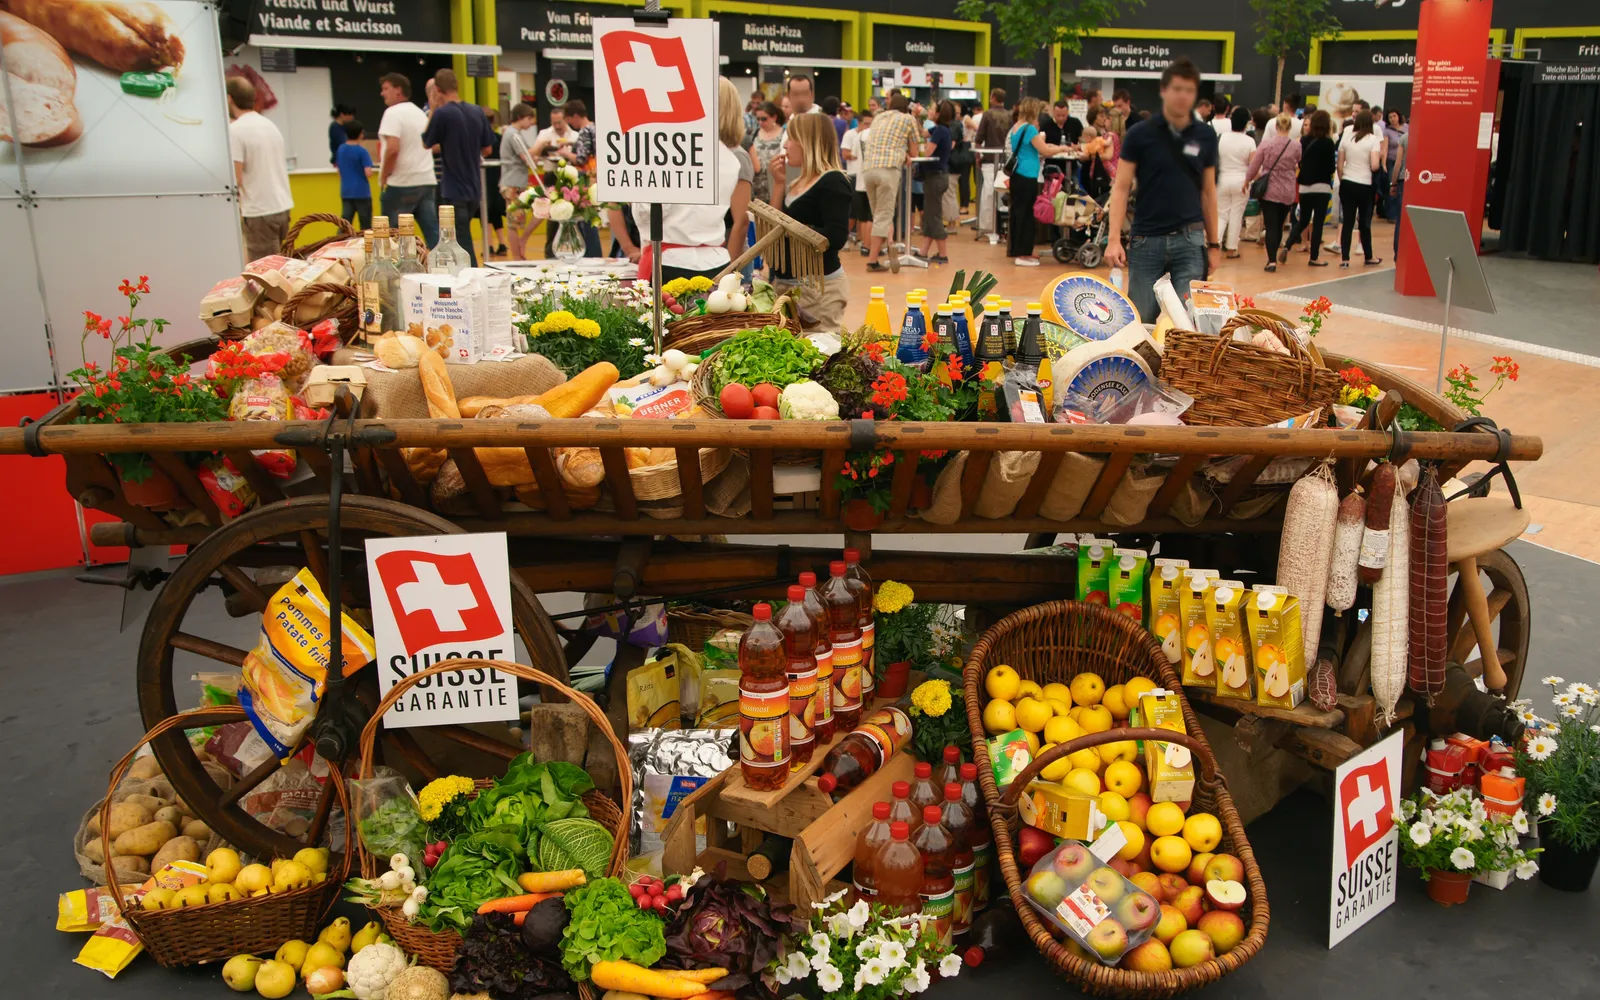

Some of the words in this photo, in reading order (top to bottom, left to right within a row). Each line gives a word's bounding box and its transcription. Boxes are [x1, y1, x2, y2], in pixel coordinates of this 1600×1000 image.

[322, 0, 349, 12] und
[353, 0, 396, 15] Wurst
[547, 10, 571, 25] Vom
[258, 13, 312, 31] Viande
[315, 17, 331, 31] et
[335, 18, 403, 35] Saucisson
[520, 27, 546, 41] Pure
[741, 38, 767, 52] Baked
[769, 40, 804, 54] Potatoes
[905, 41, 935, 54] Getränke
[1579, 44, 1600, 56] Frit
[1101, 57, 1122, 68] Dips
[1125, 57, 1137, 67] de
[606, 131, 704, 167] SUISSE
[607, 169, 704, 189] GARANTIE
[280, 596, 324, 641] Pommes
[276, 611, 309, 648] Patate
[390, 649, 506, 689] SUISSE
[394, 687, 508, 713] GARANTIE
[281, 790, 321, 799] RACLET
[1337, 840, 1393, 907] SUISSE
[1336, 875, 1392, 929] GARANTIE
